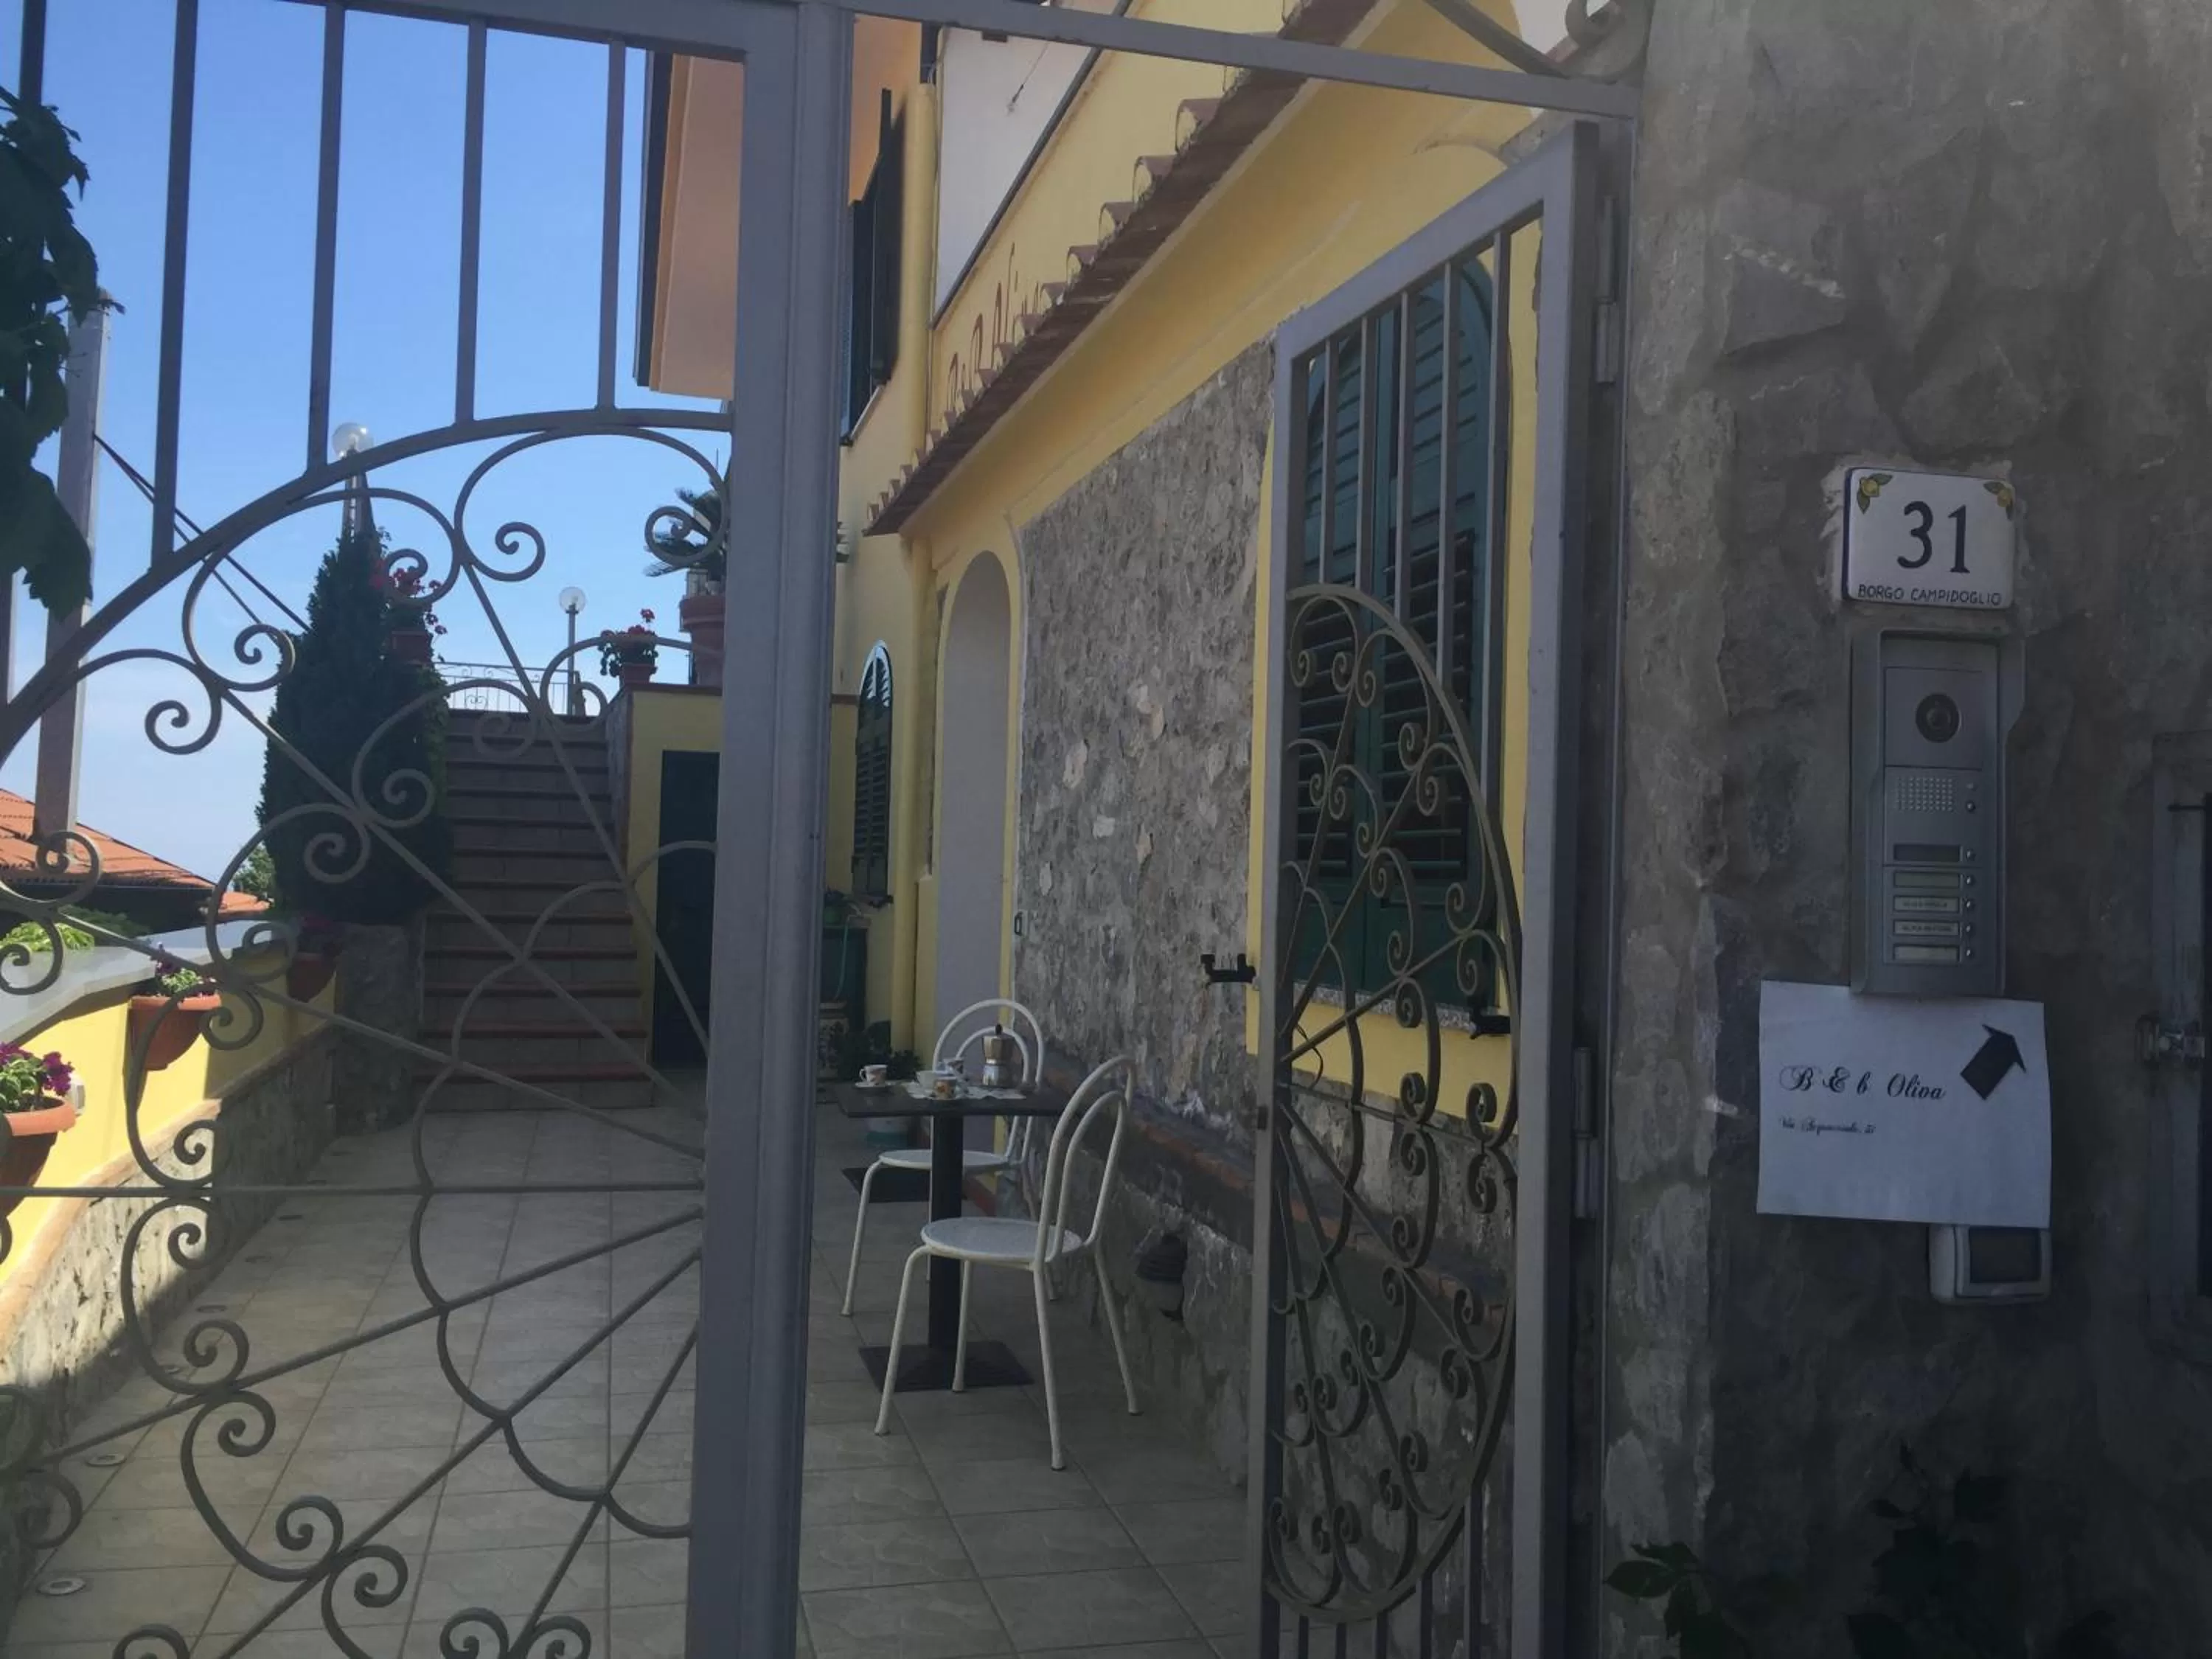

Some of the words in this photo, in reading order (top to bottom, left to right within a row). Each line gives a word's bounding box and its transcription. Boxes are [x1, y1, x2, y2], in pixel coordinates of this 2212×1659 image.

[1896, 500, 1971, 574] 31
[1857, 583, 1905, 601] BORGO
[1910, 588, 2003, 607] CAMPIDOGLIO
[1780, 1065, 1818, 1092] B
[1886, 1072, 1947, 1100] Oliva
